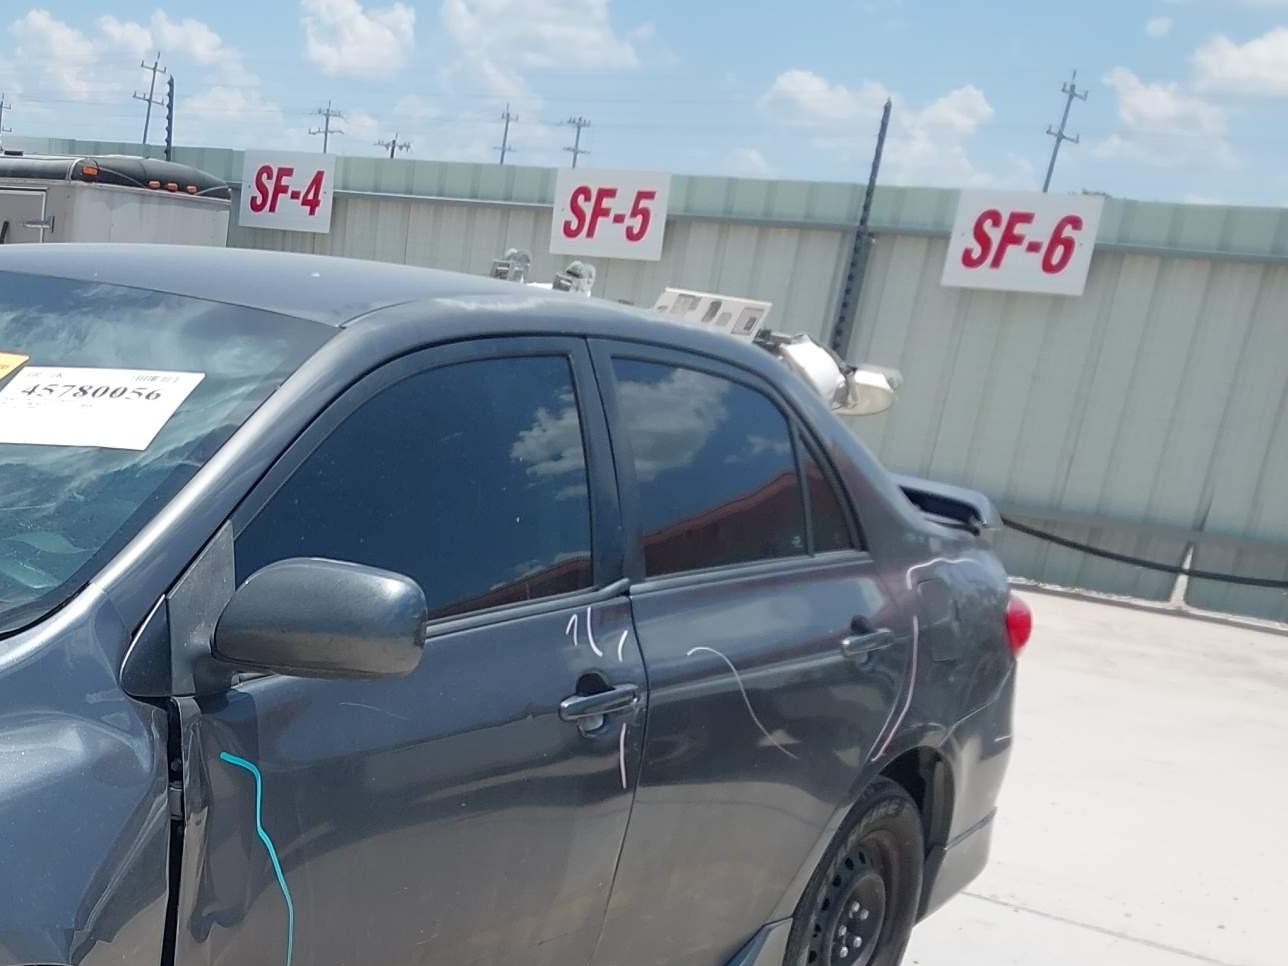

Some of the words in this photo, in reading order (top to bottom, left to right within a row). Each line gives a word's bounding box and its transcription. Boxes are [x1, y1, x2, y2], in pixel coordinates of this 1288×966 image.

[249, 164, 326, 216] SF-4
[562, 185, 656, 243] SF-5
[960, 208, 1084, 275] SF-6
[20, 383, 163, 401] 45780056
